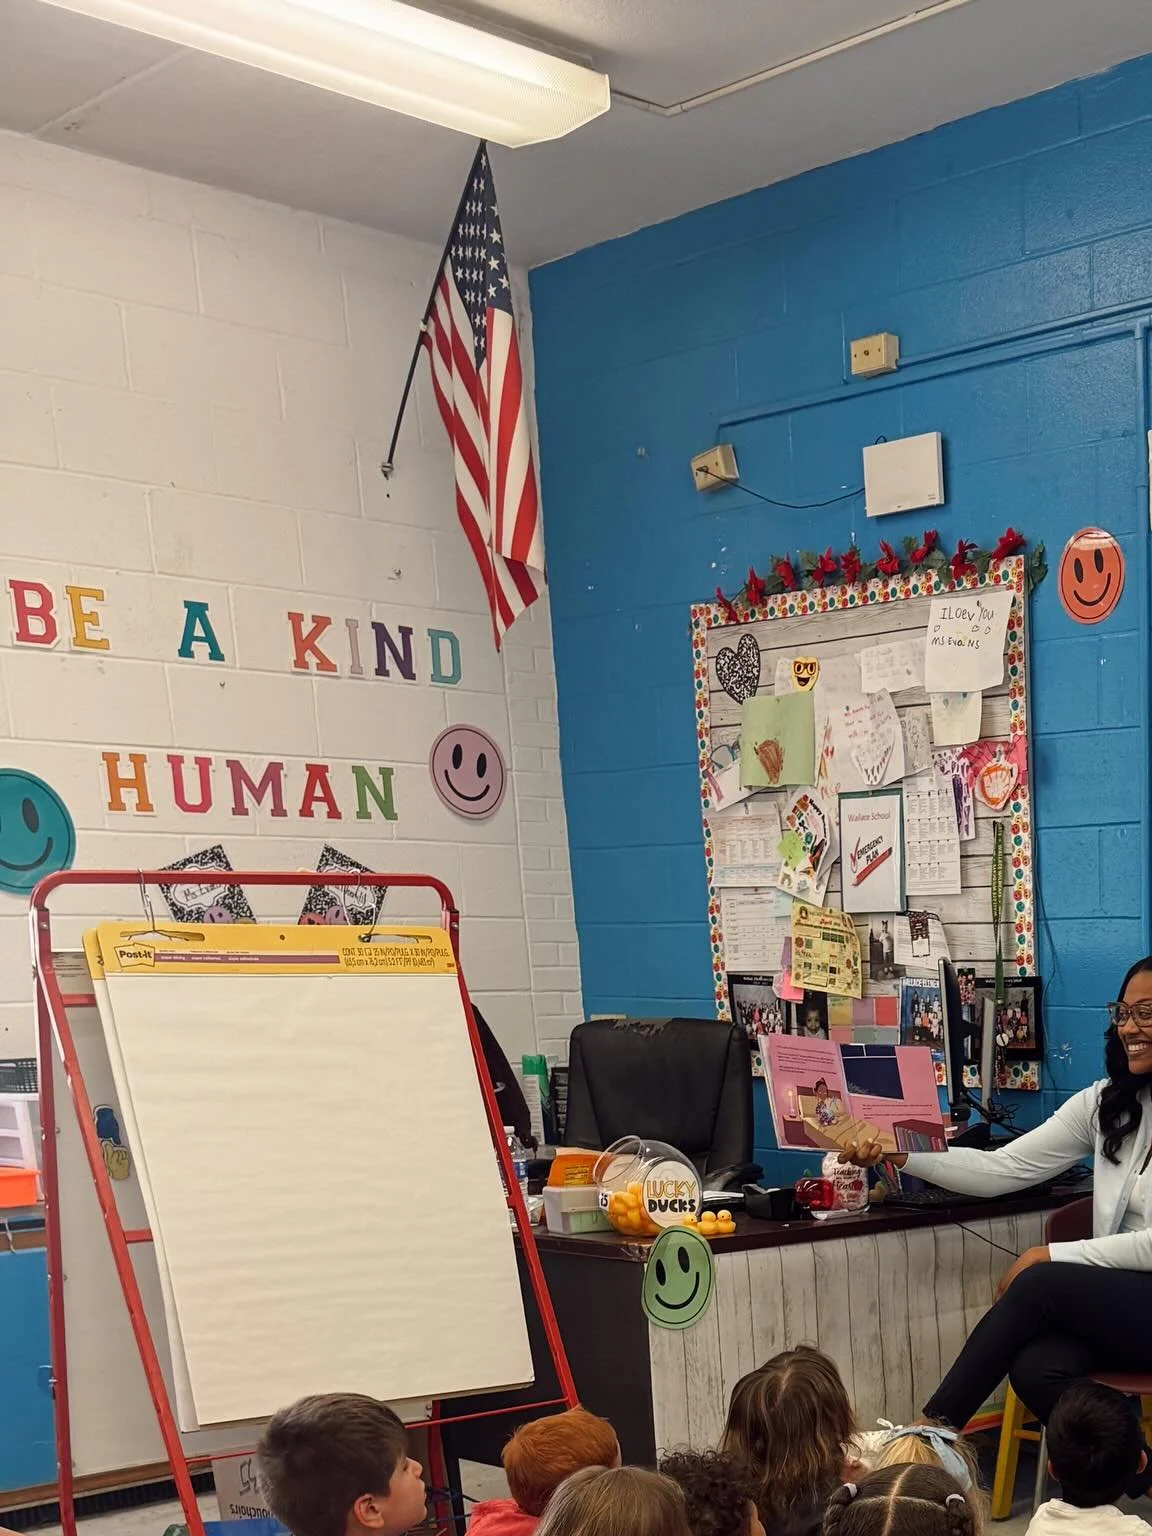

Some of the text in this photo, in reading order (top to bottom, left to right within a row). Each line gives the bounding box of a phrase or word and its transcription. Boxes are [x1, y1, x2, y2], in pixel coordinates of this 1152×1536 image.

[8, 578, 463, 685] BE A KIND
[102, 752, 398, 820] HUMAN
[848, 811, 890, 822] Wallace School
[857, 835, 883, 859] EMERGENCY
[865, 849, 879, 864] PLAN
[120, 950, 152, 959] Post-it
[647, 1180, 696, 1199] LUCKY
[648, 1199, 696, 1213] DUCKS
